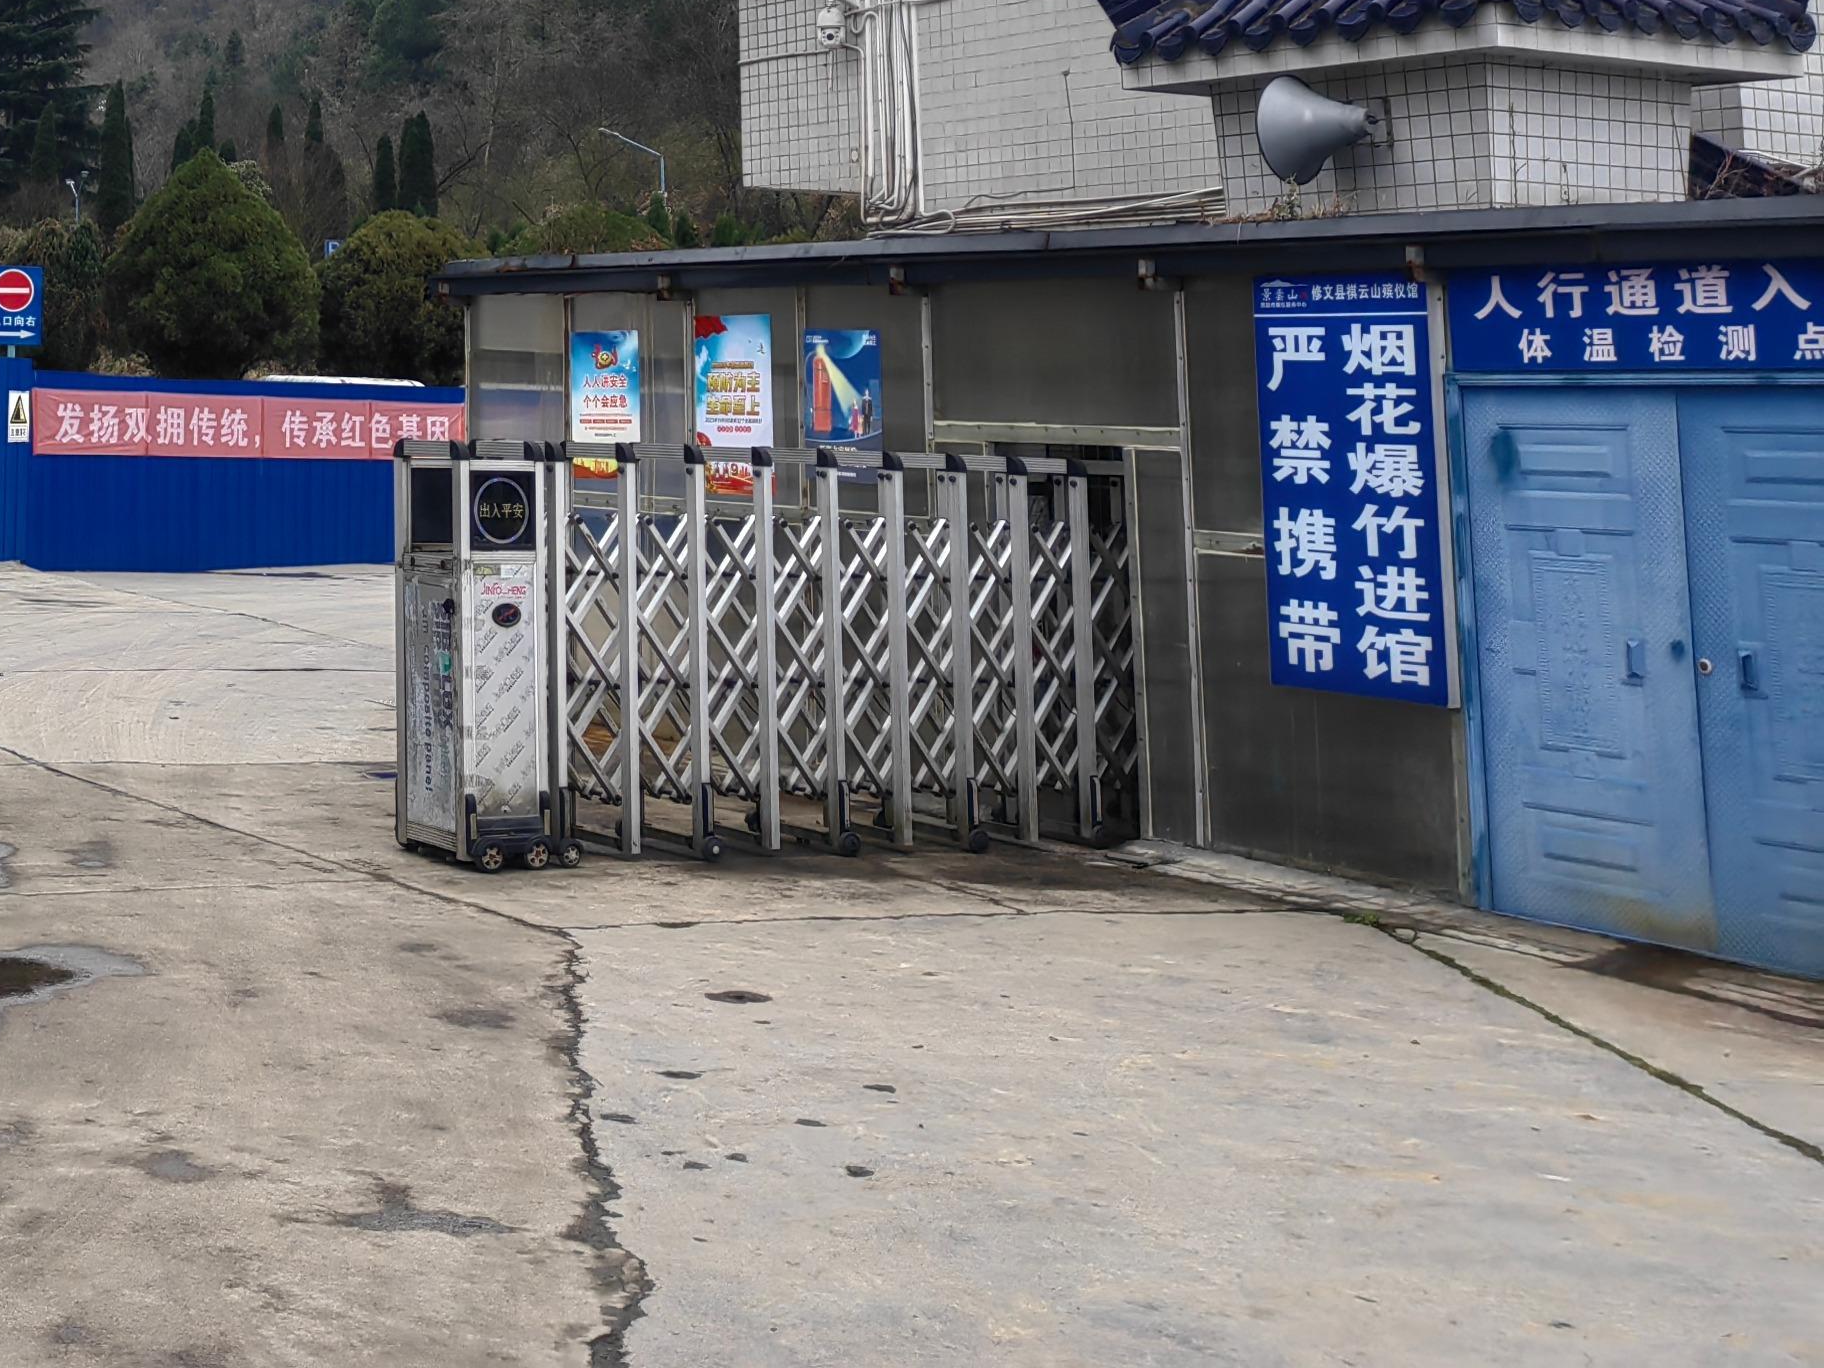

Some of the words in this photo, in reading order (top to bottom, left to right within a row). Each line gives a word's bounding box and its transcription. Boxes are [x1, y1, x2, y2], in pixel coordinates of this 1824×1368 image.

[1311, 282, 1419, 301] 修文县祺云山殡仪馆
[1473, 263, 1813, 320] 人行通道入
[1518, 321, 1824, 364] 体温检测点
[583, 374, 628, 389] 人人讲安全
[583, 394, 628, 409] 个个会应急
[706, 394, 761, 416] 生命至上
[479, 502, 525, 519] 出入平安
[1266, 325, 1342, 674] 严禁携带
[1342, 322, 1433, 688] 烟花爆竹进馆
